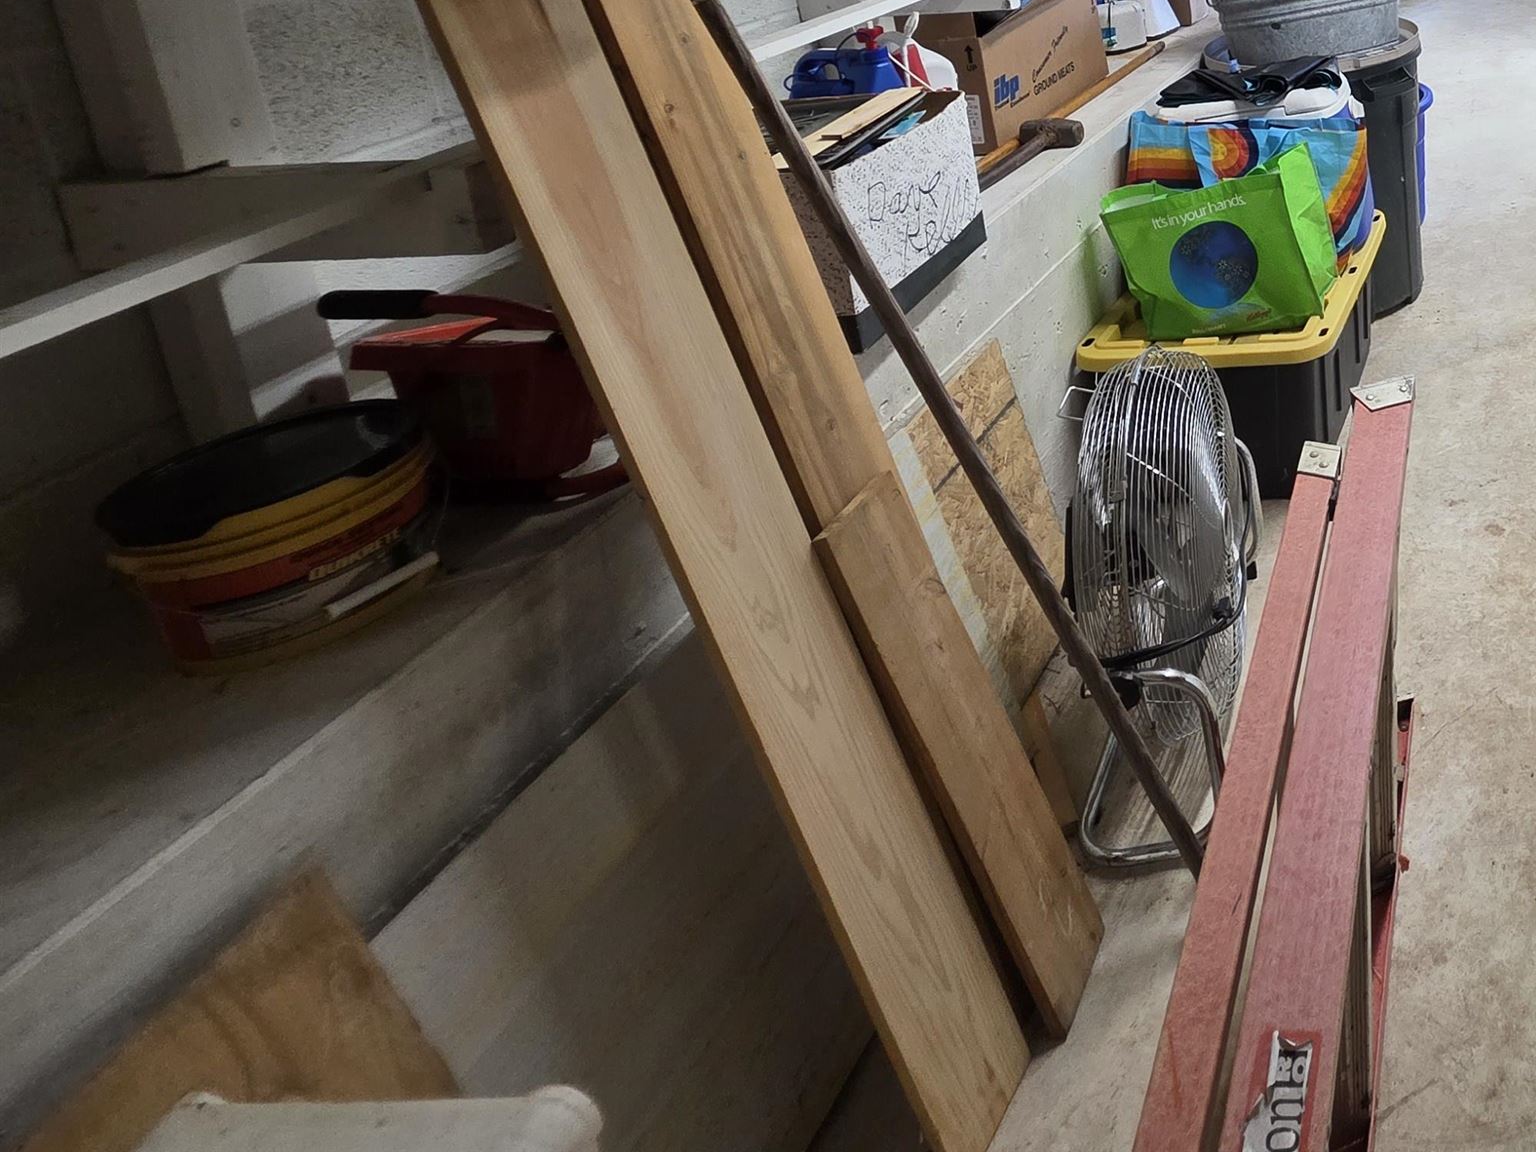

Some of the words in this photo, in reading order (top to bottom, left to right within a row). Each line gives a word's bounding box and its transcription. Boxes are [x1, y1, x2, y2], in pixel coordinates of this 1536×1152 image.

[993, 73, 1020, 105] ibp
[1032, 73, 1058, 96] GROUND
[1057, 60, 1076, 83] MEATS
[1151, 215, 1168, 230] It's
[1167, 214, 1180, 227] in
[1179, 207, 1207, 227] your
[1207, 193, 1247, 214] hands.
